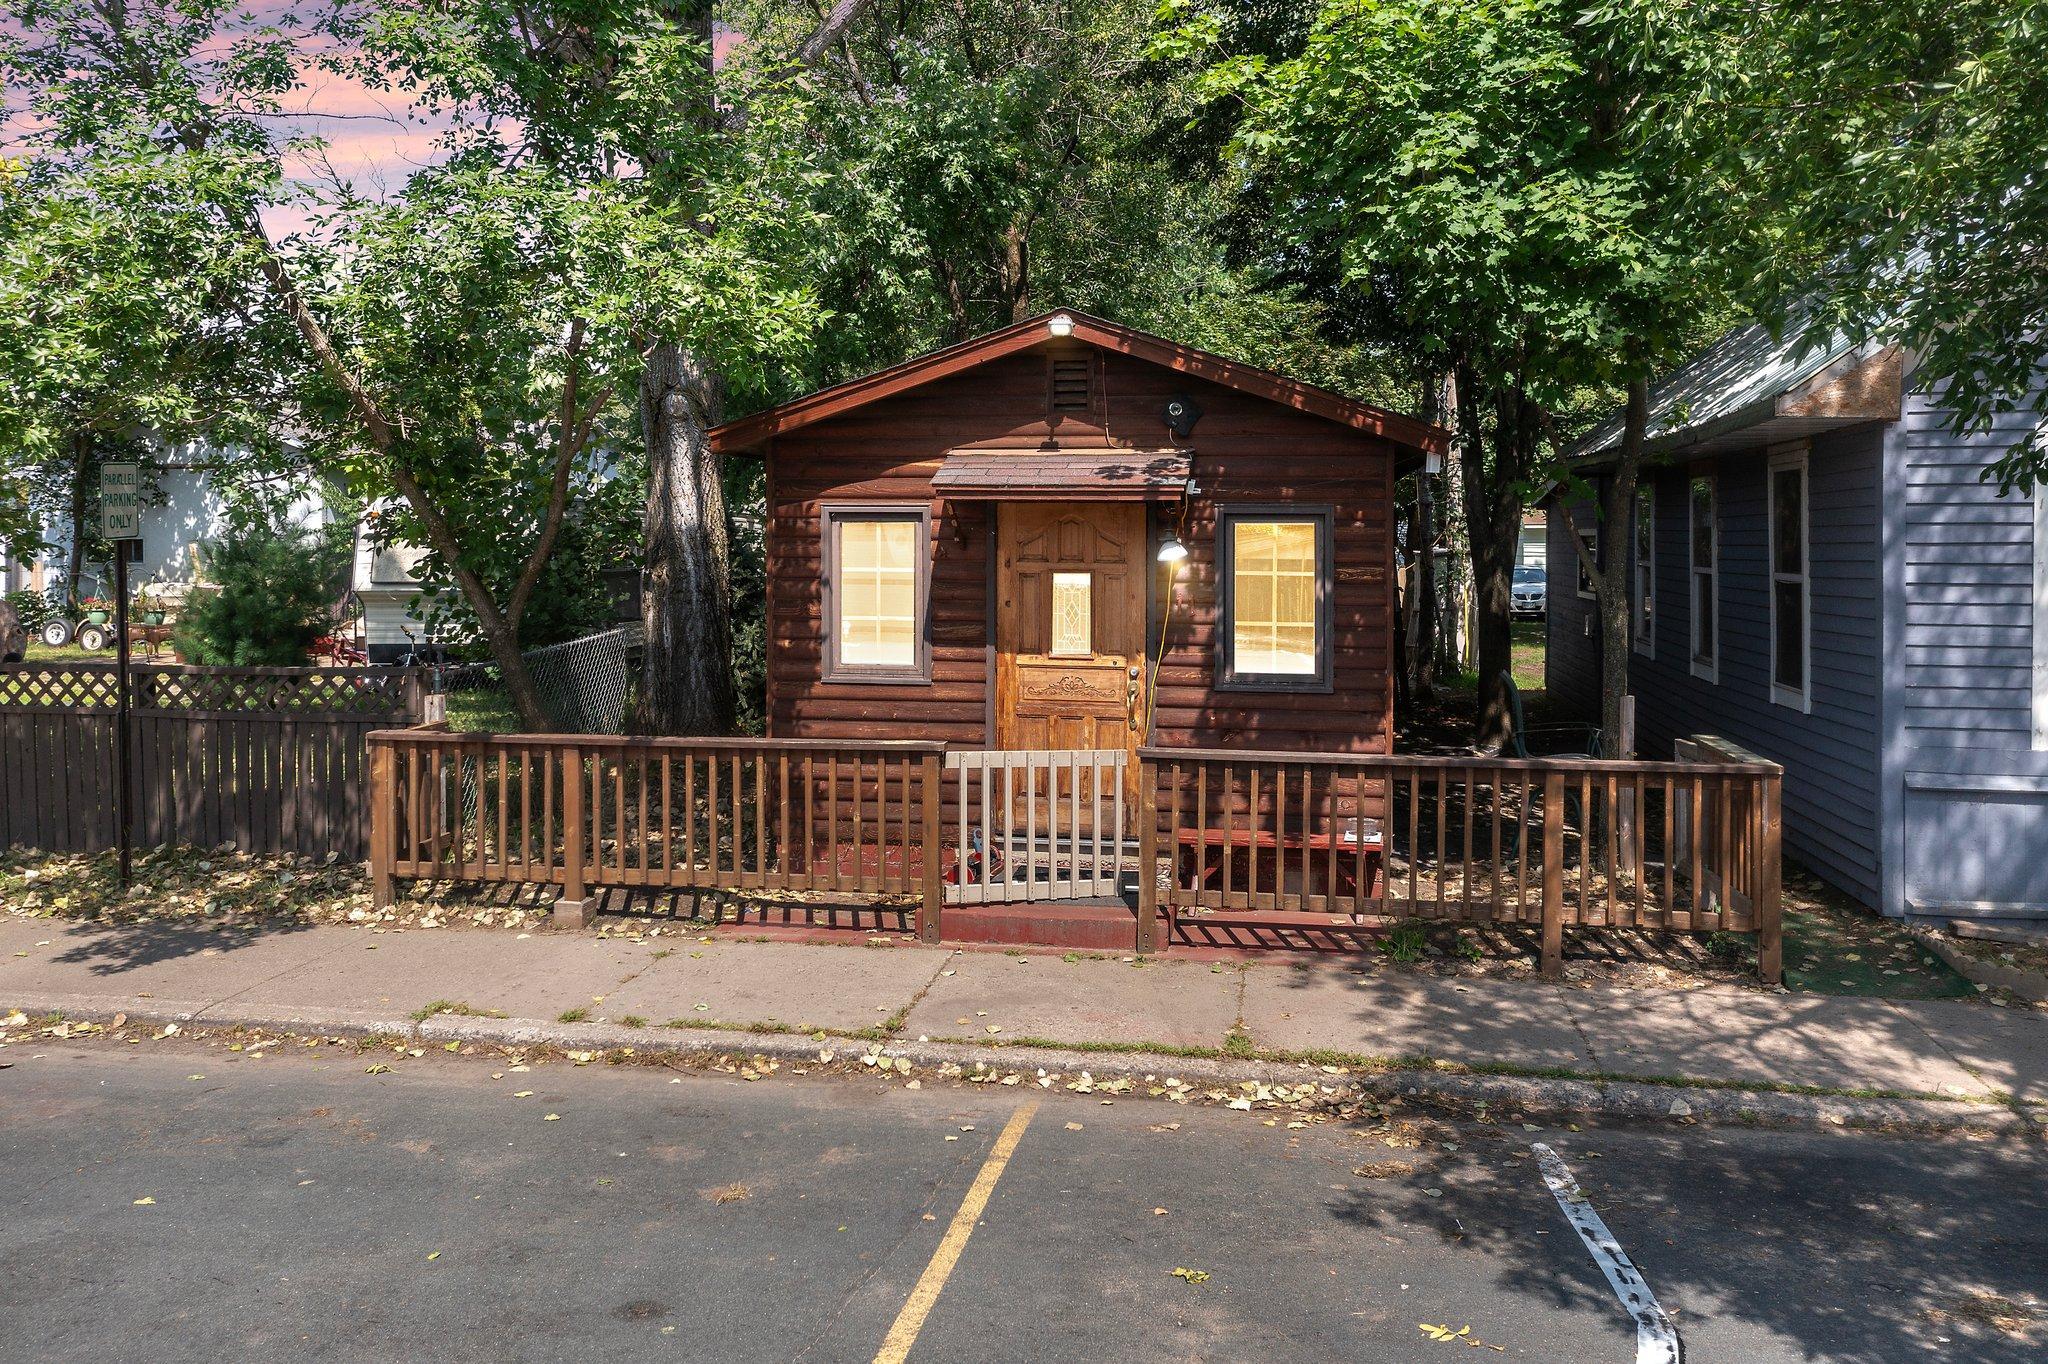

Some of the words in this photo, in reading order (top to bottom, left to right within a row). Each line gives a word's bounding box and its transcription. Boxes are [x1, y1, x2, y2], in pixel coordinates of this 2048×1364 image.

[104, 474, 136, 485] PARALLEL
[104, 493, 137, 506] PARKING
[109, 514, 132, 528] ONLY
